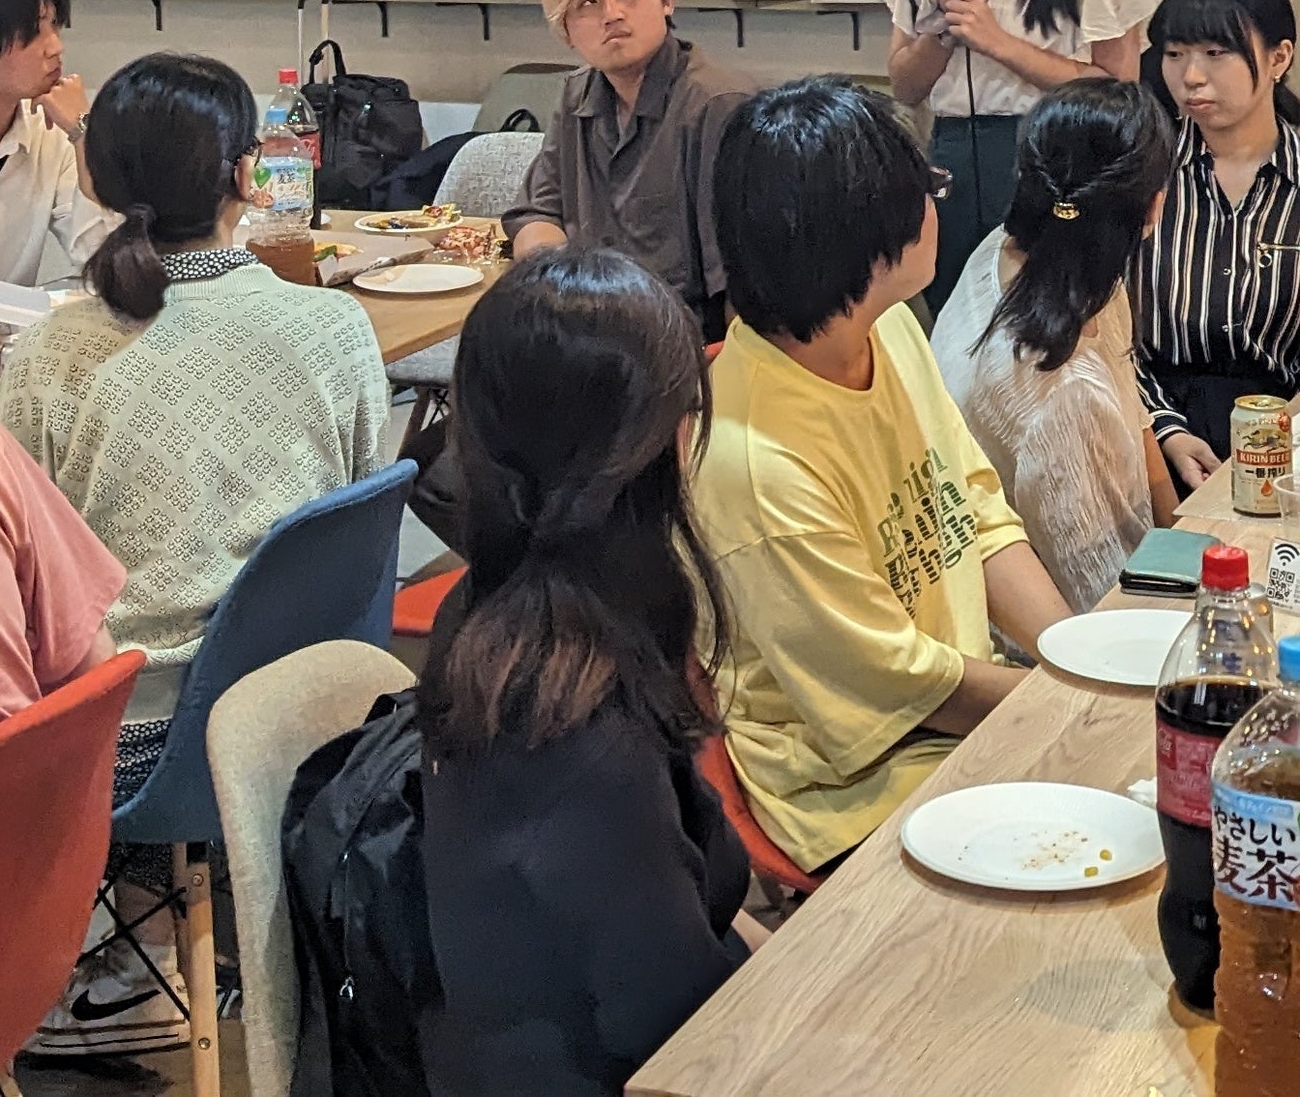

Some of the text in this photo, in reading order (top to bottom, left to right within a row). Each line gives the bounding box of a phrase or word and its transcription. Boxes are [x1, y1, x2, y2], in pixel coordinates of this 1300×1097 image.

[1241, 453, 1268, 463] KIRIN
[1212, 805, 1297, 848] やさしい
[1213, 835, 1299, 904] 麦茶
